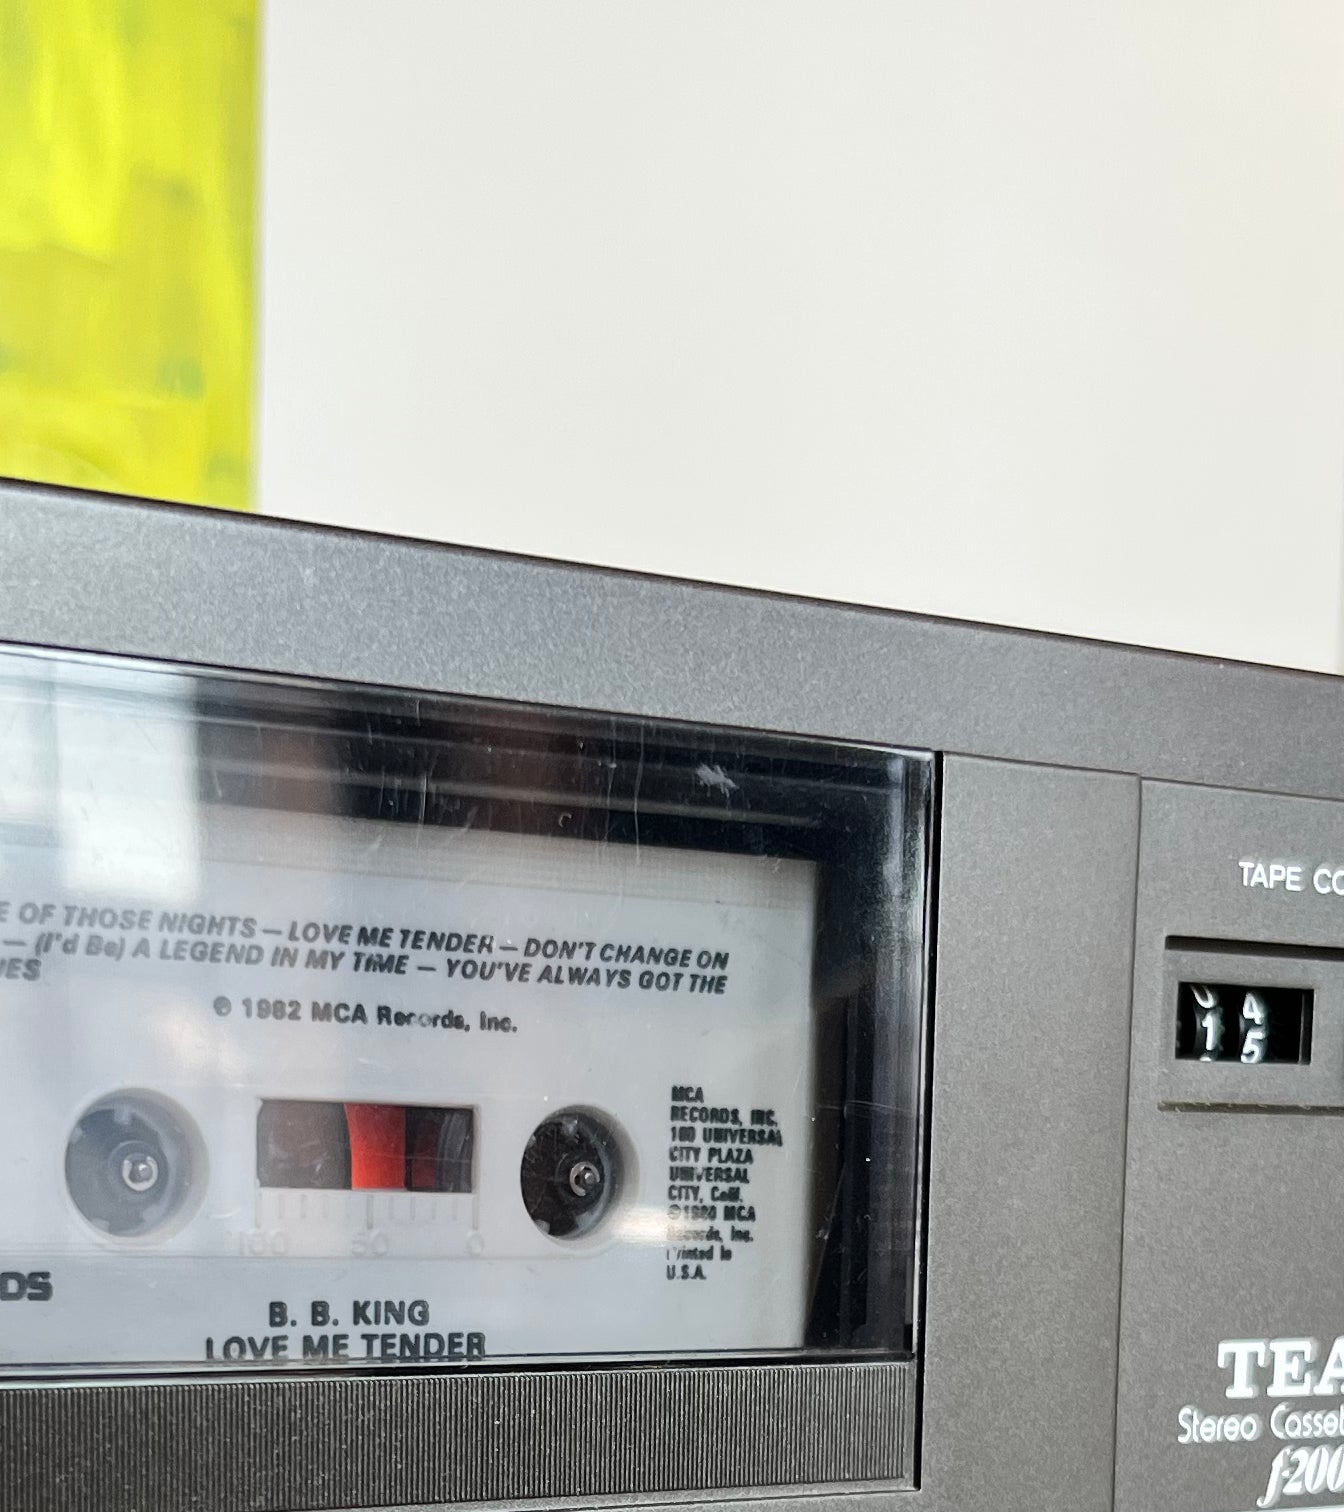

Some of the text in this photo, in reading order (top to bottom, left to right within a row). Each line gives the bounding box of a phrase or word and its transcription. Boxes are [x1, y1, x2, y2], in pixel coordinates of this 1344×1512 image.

[1239, 861, 1304, 893] TAPE
[19, 902, 56, 926] OF
[63, 905, 153, 931] THOSE
[159, 911, 258, 940] NIGHTS
[288, 921, 352, 946] LOVE
[357, 926, 393, 949] ME
[524, 937, 597, 962] DON'T
[599, 943, 693, 970] CHANGE
[696, 949, 730, 972] ON
[131, 938, 153, 960] A
[159, 939, 265, 966] LEGEND
[270, 945, 299, 969] IN
[303, 948, 346, 971] MY
[353, 952, 408, 976] TIME
[447, 959, 531, 984] YOU'VE
[537, 965, 633, 990] ALWAYS
[638, 970, 682, 993] GOT
[687, 973, 728, 996] THE
[311, 1000, 369, 1025] MCA
[479, 1009, 519, 1034] Inc.
[671, 1085, 704, 1103] MCA
[670, 1105, 743, 1127] RECORDS,
[702, 1127, 783, 1147] UNIVERSAL
[669, 1146, 754, 1164] CITY PLAZA
[669, 1166, 750, 1184] UNIVERSAL
[723, 1205, 756, 1222] MCA
[269, 1299, 430, 1328] B. B. KING
[205, 1332, 487, 1361] LOVE ME TENDER
[1177, 1404, 1261, 1444] Stereo
